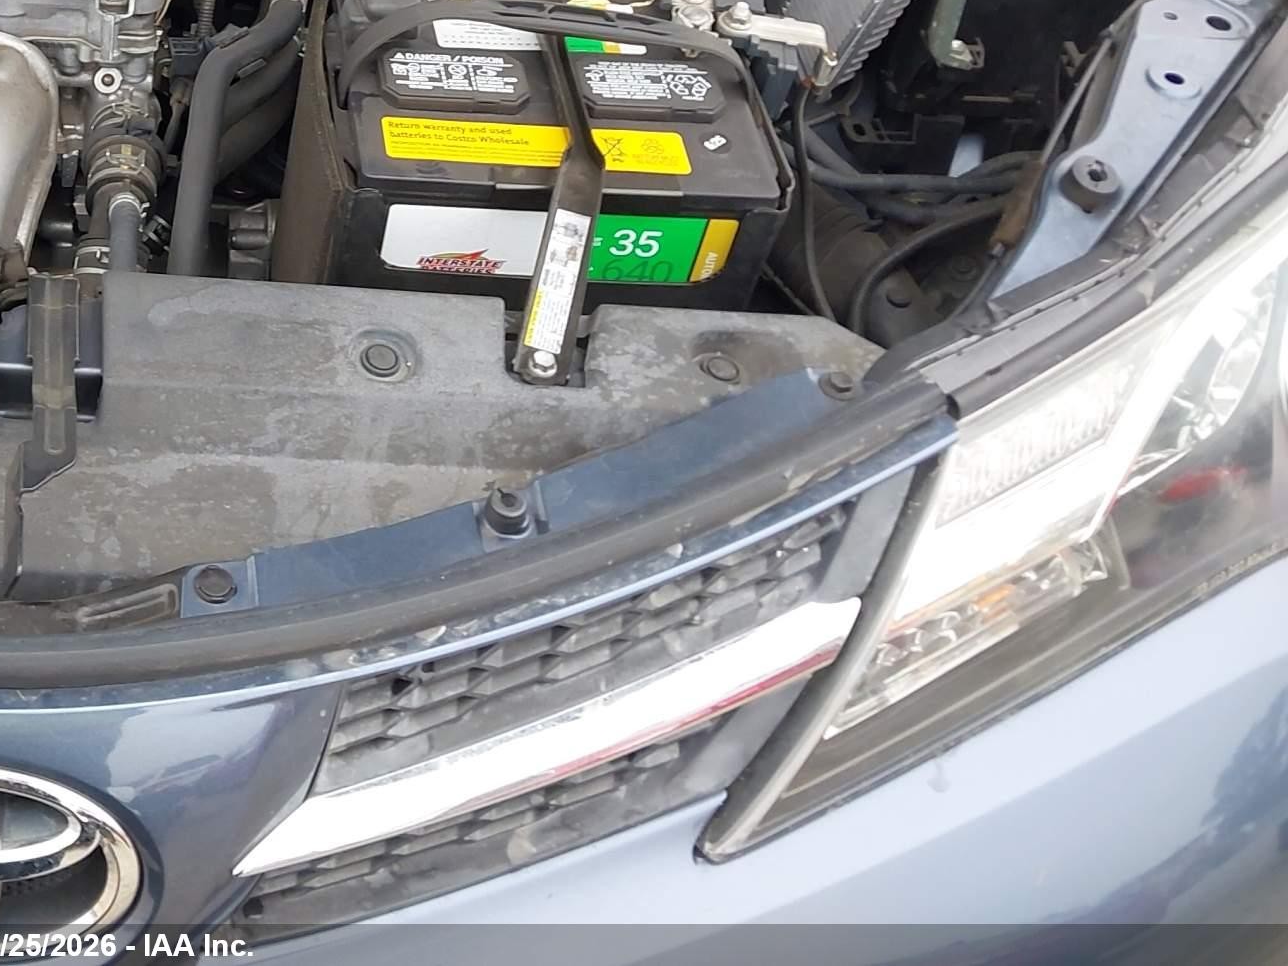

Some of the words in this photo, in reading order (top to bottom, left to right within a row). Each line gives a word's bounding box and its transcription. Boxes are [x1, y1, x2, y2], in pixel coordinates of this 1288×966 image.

[405, 52, 451, 62] DANGER
[462, 55, 504, 64] POISON
[388, 121, 421, 129] Return
[423, 124, 466, 134] warranty
[469, 126, 487, 134] and
[489, 127, 513, 135] used
[389, 131, 432, 140] batteries
[479, 135, 530, 146] Wholesale
[609, 229, 663, 258] 35
[416, 256, 504, 270] INTERSTATE
